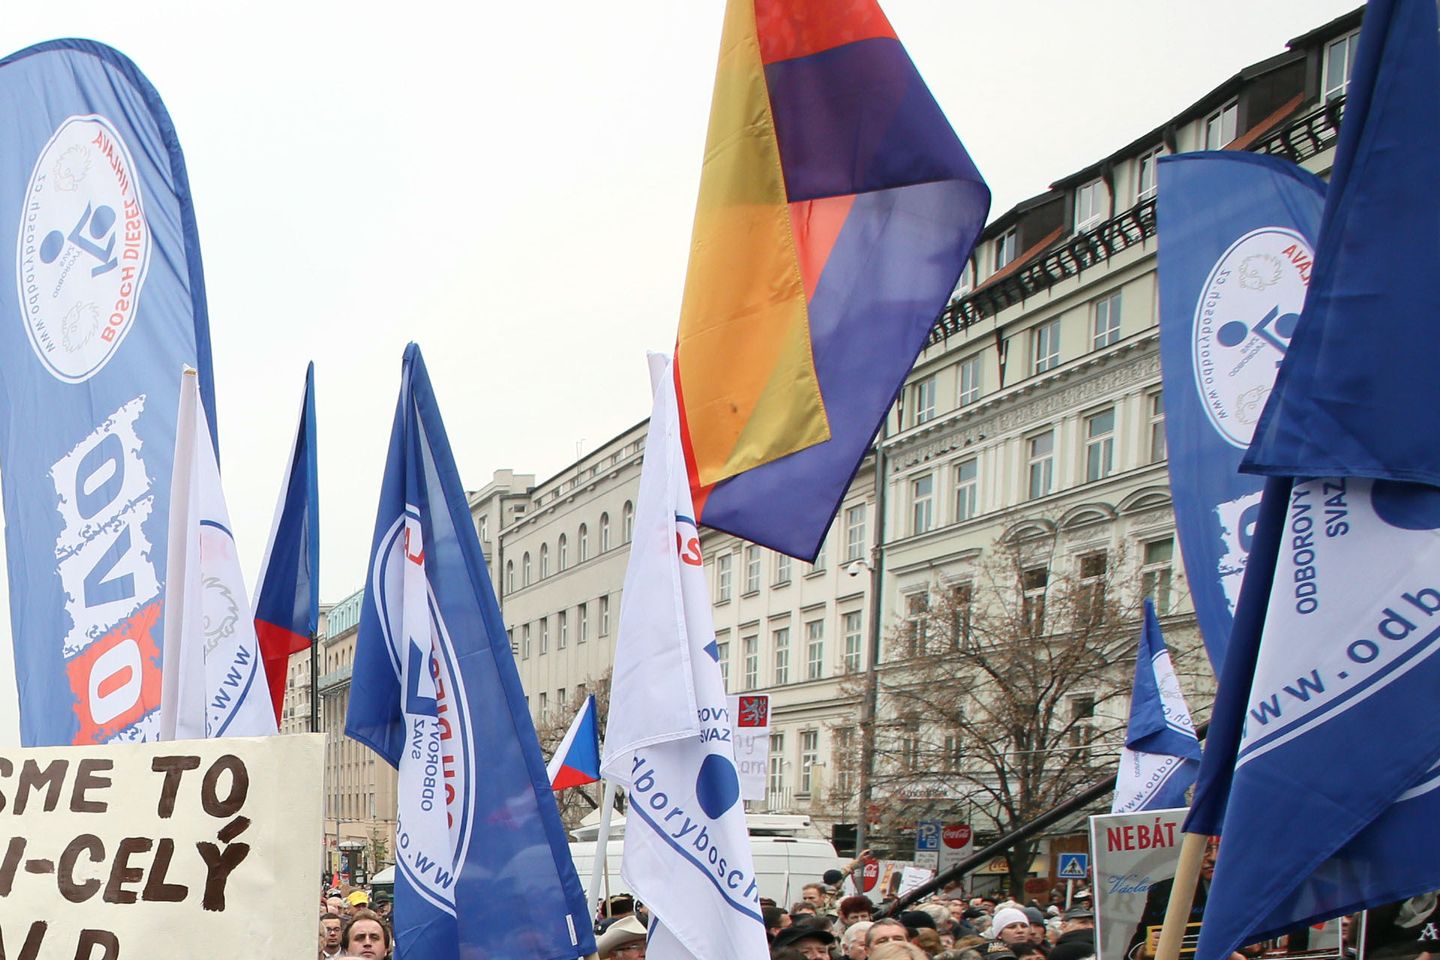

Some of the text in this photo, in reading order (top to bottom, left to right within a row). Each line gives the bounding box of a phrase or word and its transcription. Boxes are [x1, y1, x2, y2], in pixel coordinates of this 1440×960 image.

[1325, 478, 1350, 538] SVAZ
[151, 753, 250, 820] TO
[1107, 818, 1176, 852] NEBÁT
